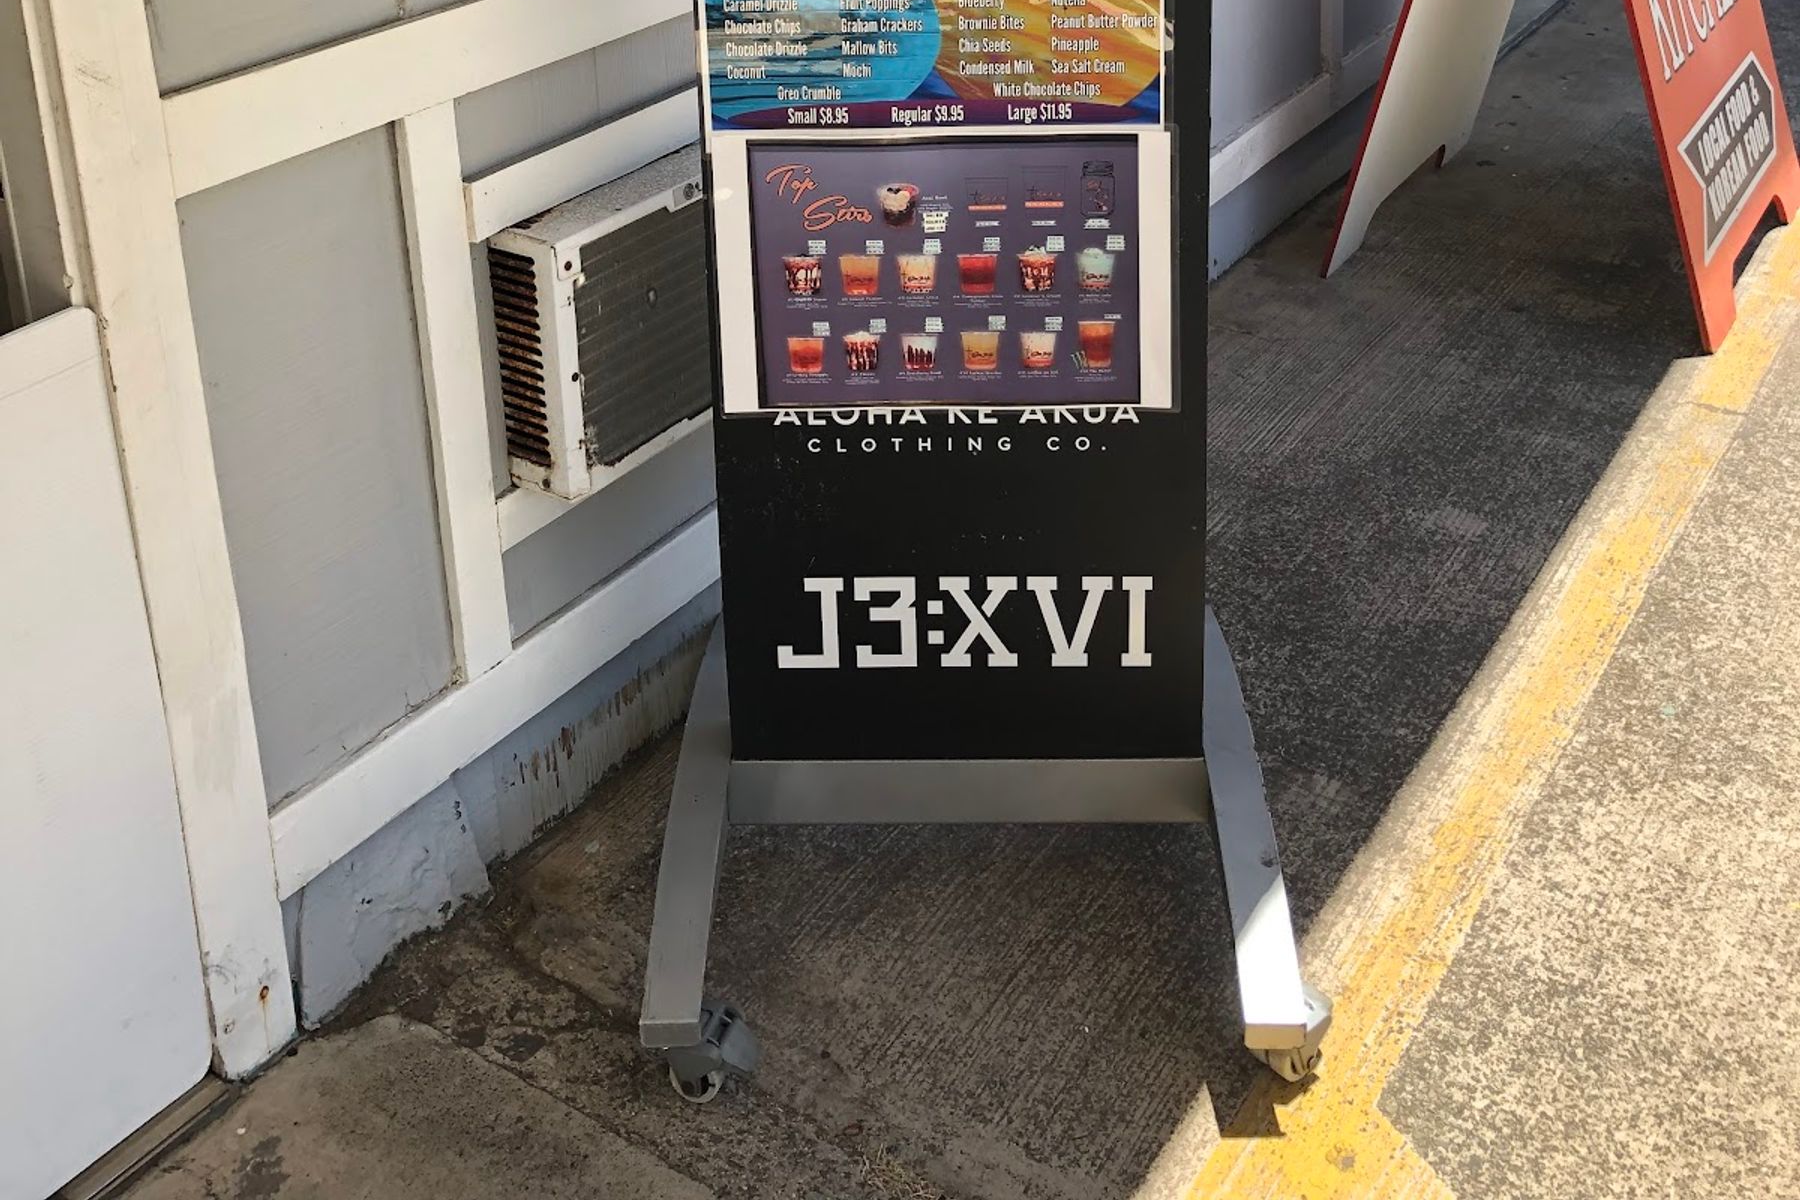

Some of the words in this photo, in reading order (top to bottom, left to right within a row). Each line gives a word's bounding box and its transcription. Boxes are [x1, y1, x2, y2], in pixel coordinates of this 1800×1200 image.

[959, 16, 996, 30] Brownie
[1000, 16, 1024, 29] Bites
[1051, 15, 1085, 29] Peanut
[1087, 14, 1118, 28] Butter
[1121, 13, 1158, 28] Powder
[1051, 37, 1099, 53] Pineapple
[788, 108, 817, 124] Small
[820, 107, 848, 126] $8.95
[891, 107, 932, 125] Regular
[934, 105, 964, 122] $9.95
[1008, 105, 1037, 123] Large
[1040, 104, 1072, 120] $11.95
[1698, 111, 1730, 176] LOCAL
[1725, 81, 1752, 138] FOOD
[1749, 75, 1760, 106] &
[1708, 142, 1748, 222] KOREAN
[1744, 111, 1770, 167] FOOD
[765, 164, 818, 204] Top
[773, 408, 927, 425] ALOHA
[948, 408, 998, 424] KE
[1019, 406, 1140, 424] AKUA
[807, 436, 1012, 453] CLOTHING
[1046, 436, 1107, 451] CO.
